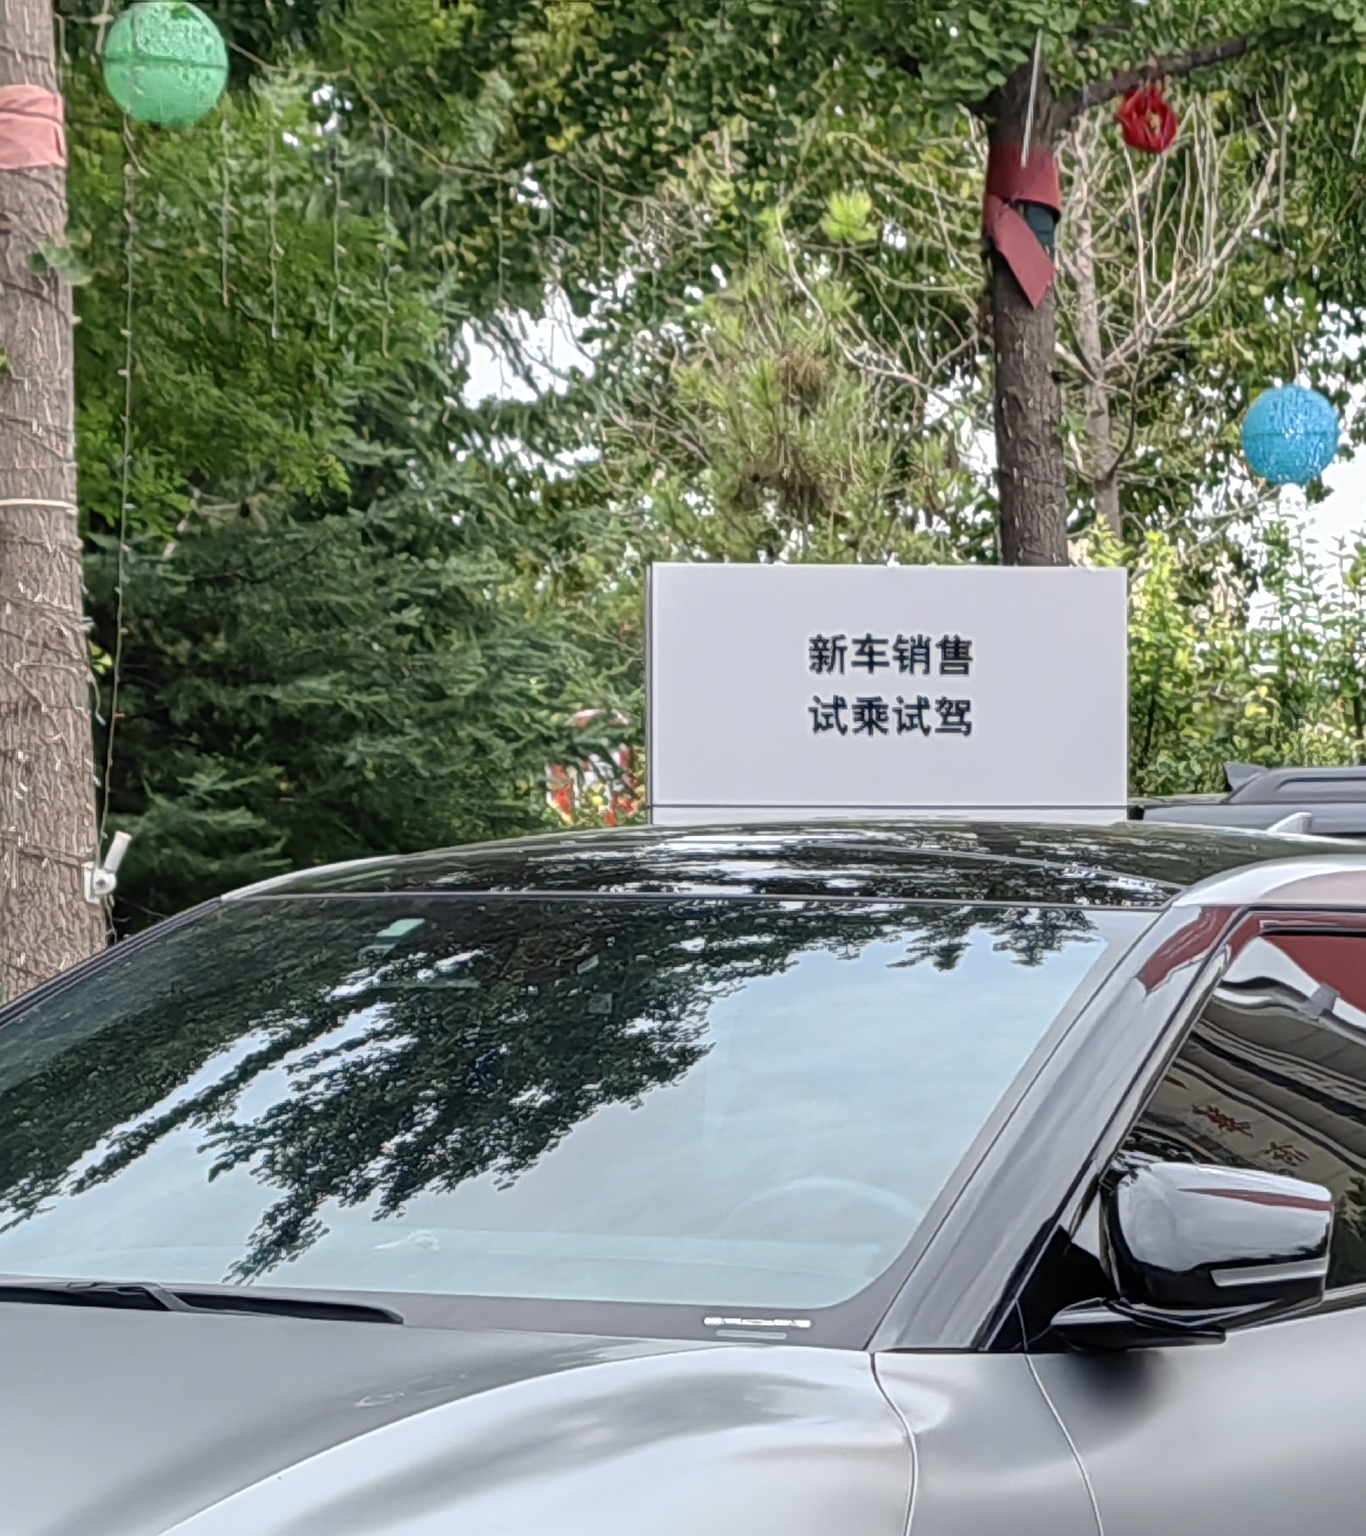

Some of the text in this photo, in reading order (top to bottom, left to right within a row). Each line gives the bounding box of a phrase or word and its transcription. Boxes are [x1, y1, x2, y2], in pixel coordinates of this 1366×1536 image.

[808, 632, 974, 676] 新车销售
[807, 694, 973, 737] 试乘试驾
